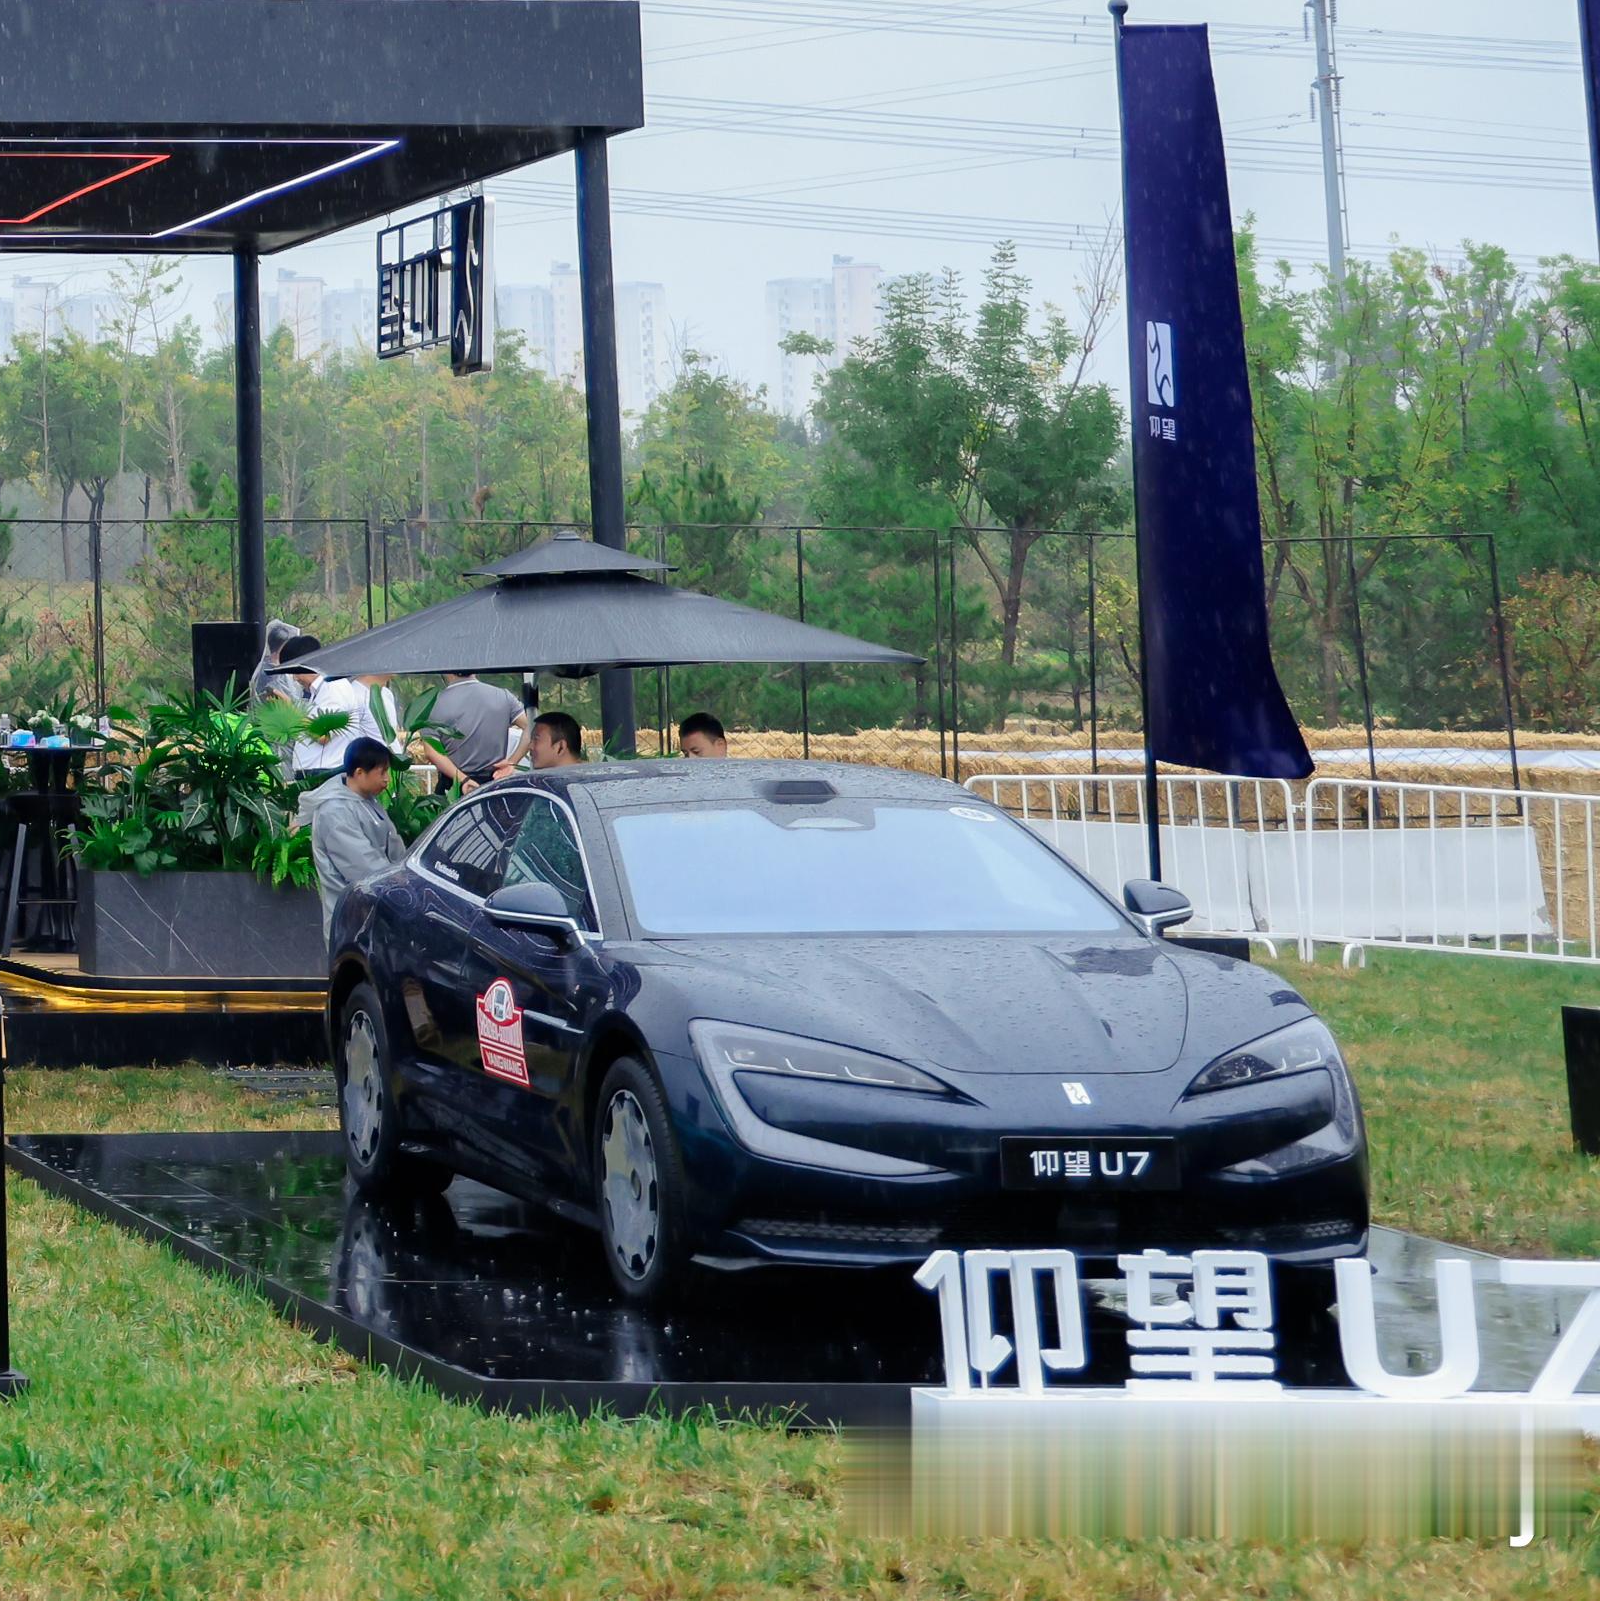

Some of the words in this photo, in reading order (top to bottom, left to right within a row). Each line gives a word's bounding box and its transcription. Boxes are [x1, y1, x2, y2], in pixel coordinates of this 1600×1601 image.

[1149, 415, 1177, 441] 仰望
[1029, 1150, 1091, 1177] 仰望
[1100, 1151, 1150, 1176] U7
[912, 1249, 1283, 1396] 仰望
[1334, 1258, 1600, 1399] U7
